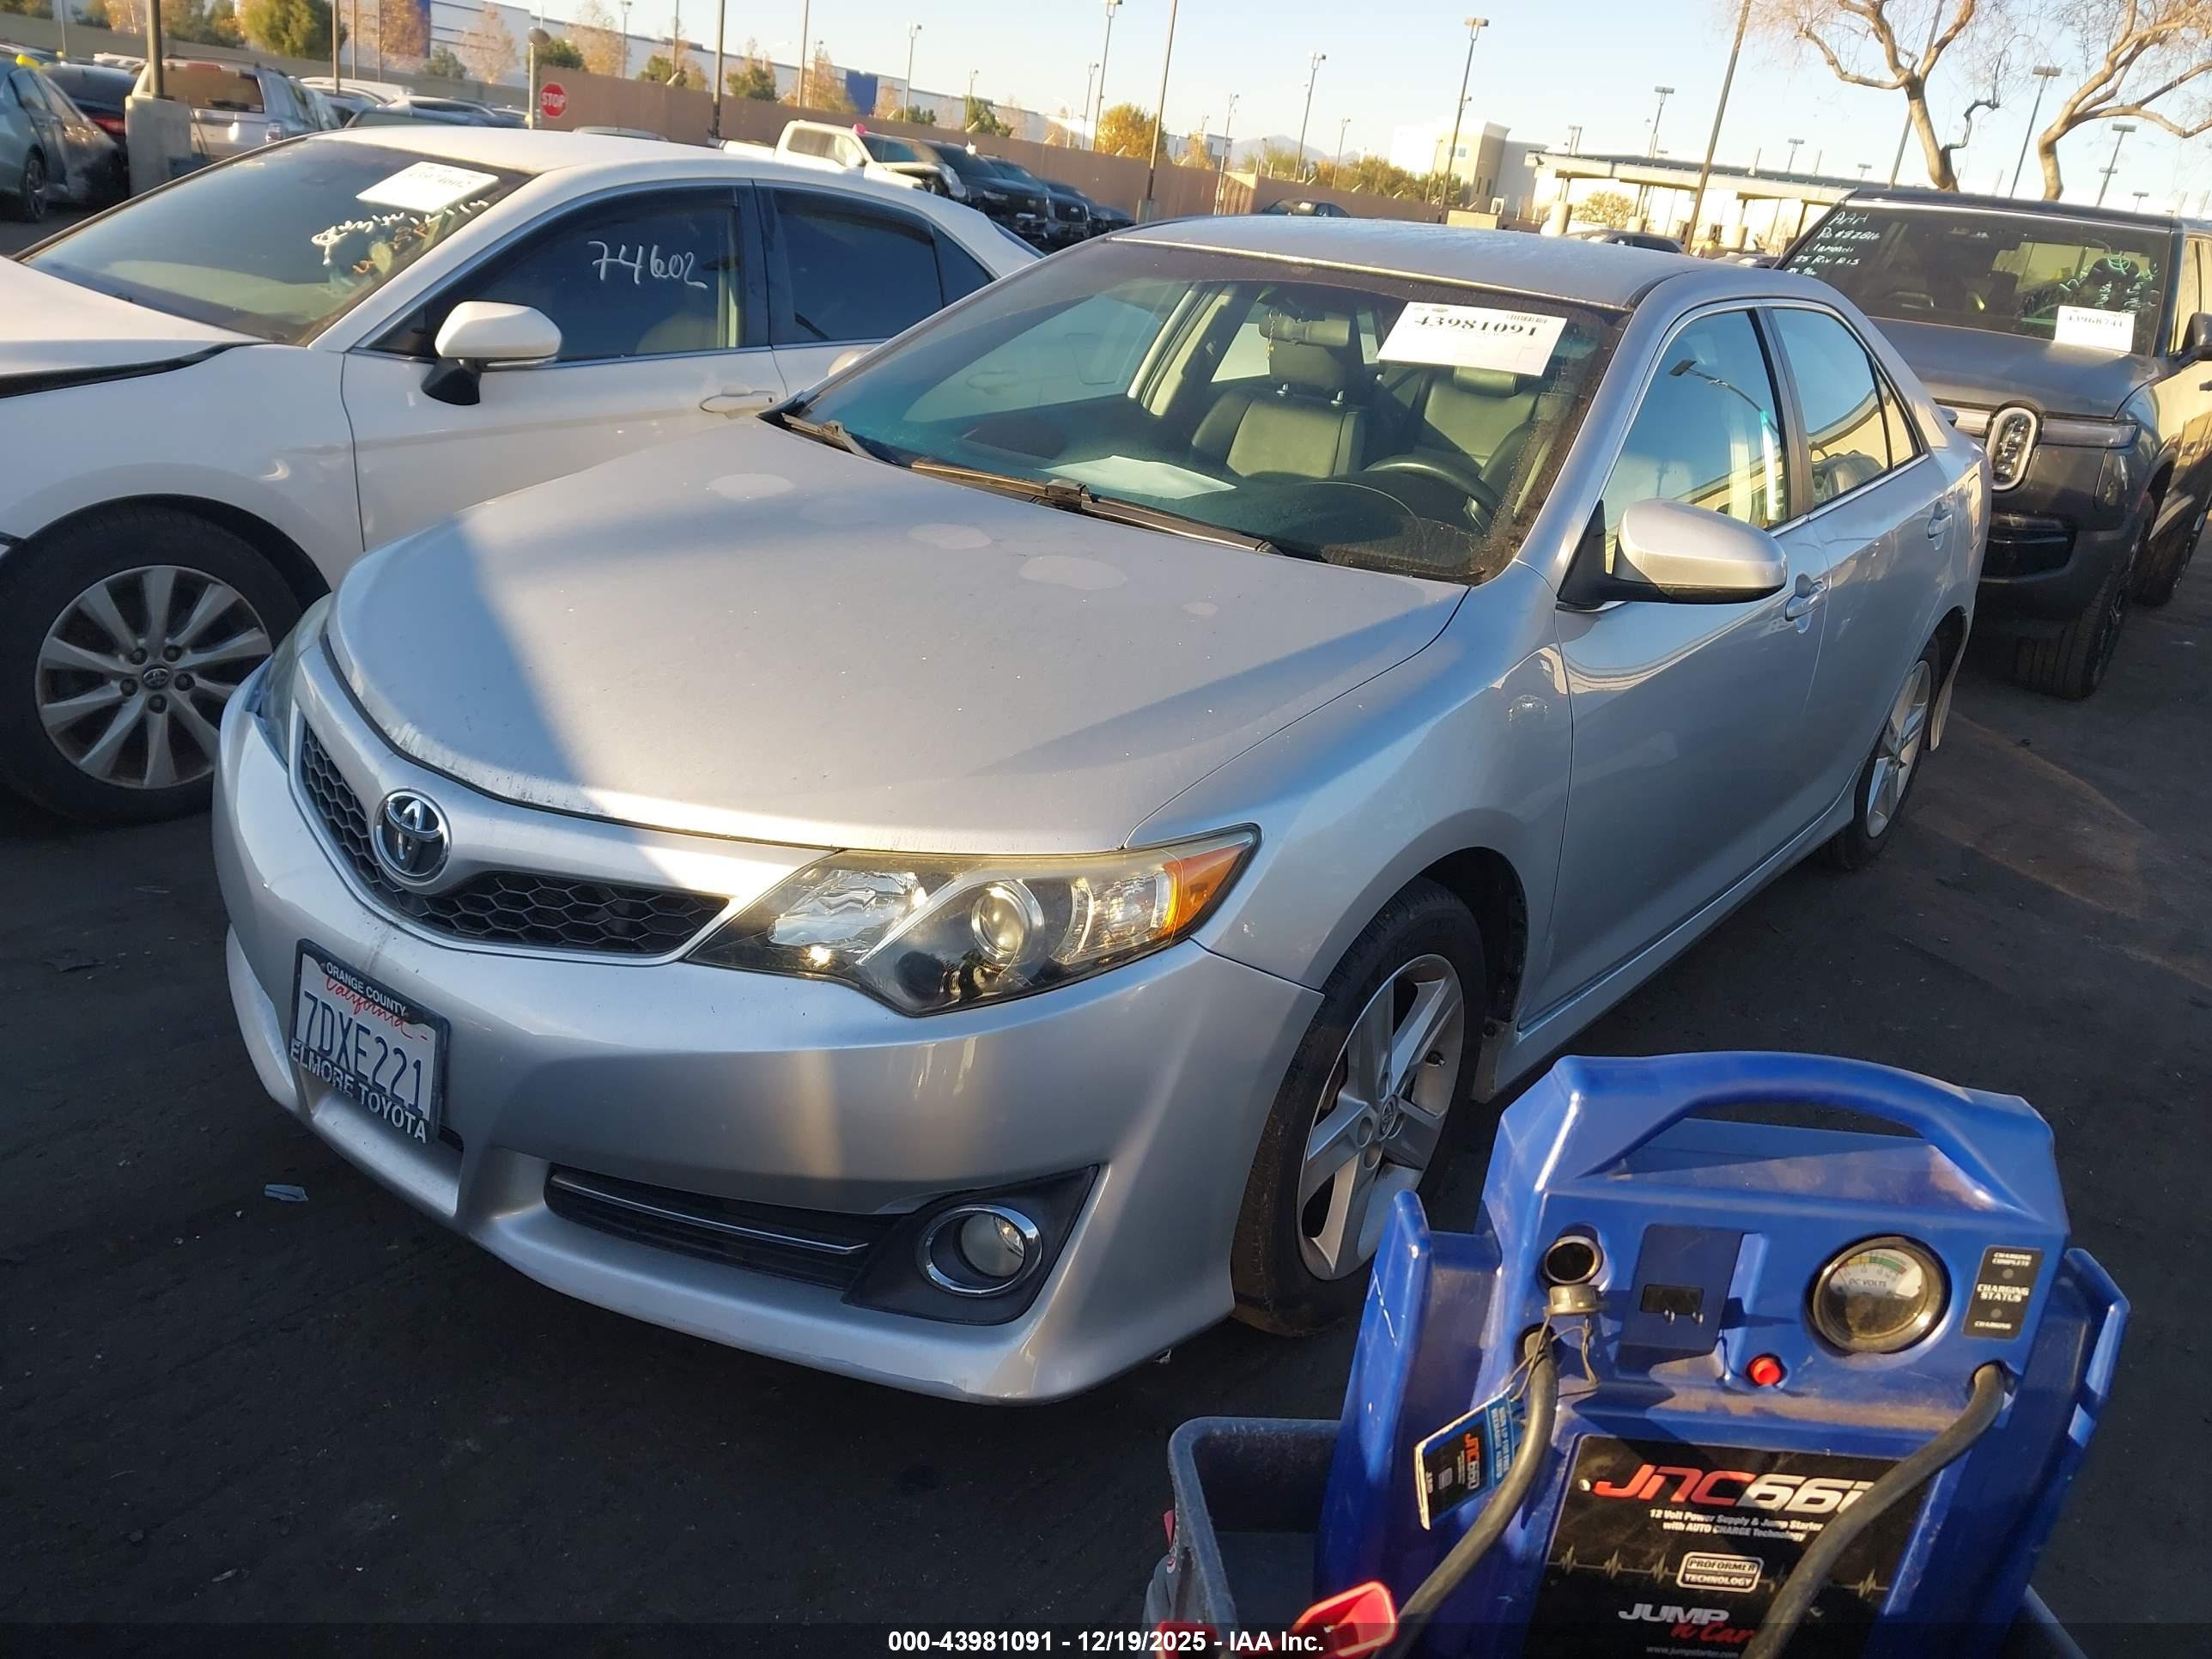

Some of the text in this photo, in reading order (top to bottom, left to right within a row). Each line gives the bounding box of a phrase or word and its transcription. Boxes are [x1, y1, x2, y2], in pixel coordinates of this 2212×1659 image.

[542, 92, 566, 106] STOP
[588, 241, 708, 289] 74602
[1414, 315, 1538, 337] 43981091
[326, 962, 407, 1015] ORANGE COUNTY
[303, 990, 424, 1116] 7DXE221
[289, 1038, 427, 1144] ELMORE TOYOTA
[1863, 1279, 1887, 1287] VOLTS
[1977, 1283, 2030, 1297] CHARGING
[1979, 1291, 2022, 1303] STATUS
[1649, 1509, 1824, 1532] 12 Volt Power Supply & Jump Starter
[1662, 1521, 1807, 1542] with AUTO CHARGE Technology
[1688, 1559, 1756, 1572] PROFORMER
[1684, 1574, 1753, 1587] TECHNOLOGY
[1618, 1602, 1730, 1626] JUMP
